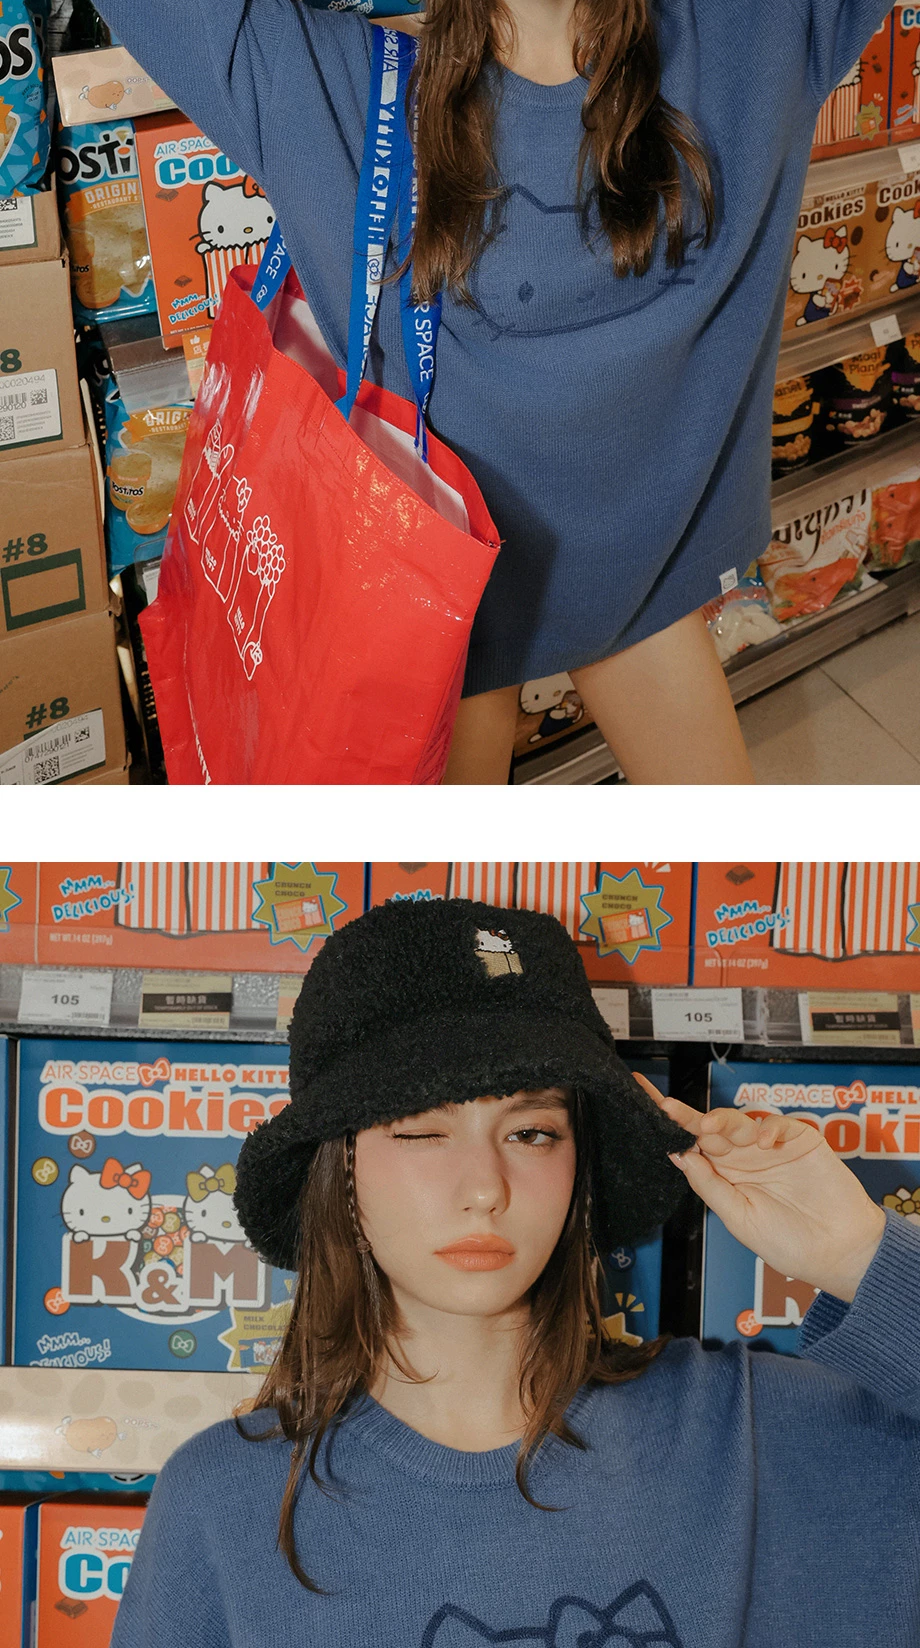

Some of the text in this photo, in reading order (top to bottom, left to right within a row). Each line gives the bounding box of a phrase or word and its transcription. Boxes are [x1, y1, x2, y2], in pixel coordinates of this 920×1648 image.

[156, 142, 178, 156] AIR
[798, 198, 864, 230] ookies
[168, 294, 219, 325] DELICIOUS!
[413, 316, 437, 383] SPACE
[3, 533, 48, 563] #8
[25, 697, 70, 729] #8
[275, 881, 311, 889] CRUNCH
[51, 883, 135, 922] DELICIOUS!
[601, 894, 638, 902] CRUNCH
[706, 908, 791, 948] DELICIOUS!
[51, 994, 79, 1005] 105
[684, 1012, 713, 1023] 105
[44, 1064, 73, 1081] AIR
[79, 1064, 137, 1082] SPACE
[174, 1067, 237, 1084] HELLO
[738, 1086, 768, 1103] AIR
[774, 1086, 834, 1104] SPACE
[68, 1240, 260, 1306] K&M
[243, 1315, 265, 1323] MILK
[65, 1530, 92, 1546] AIR
